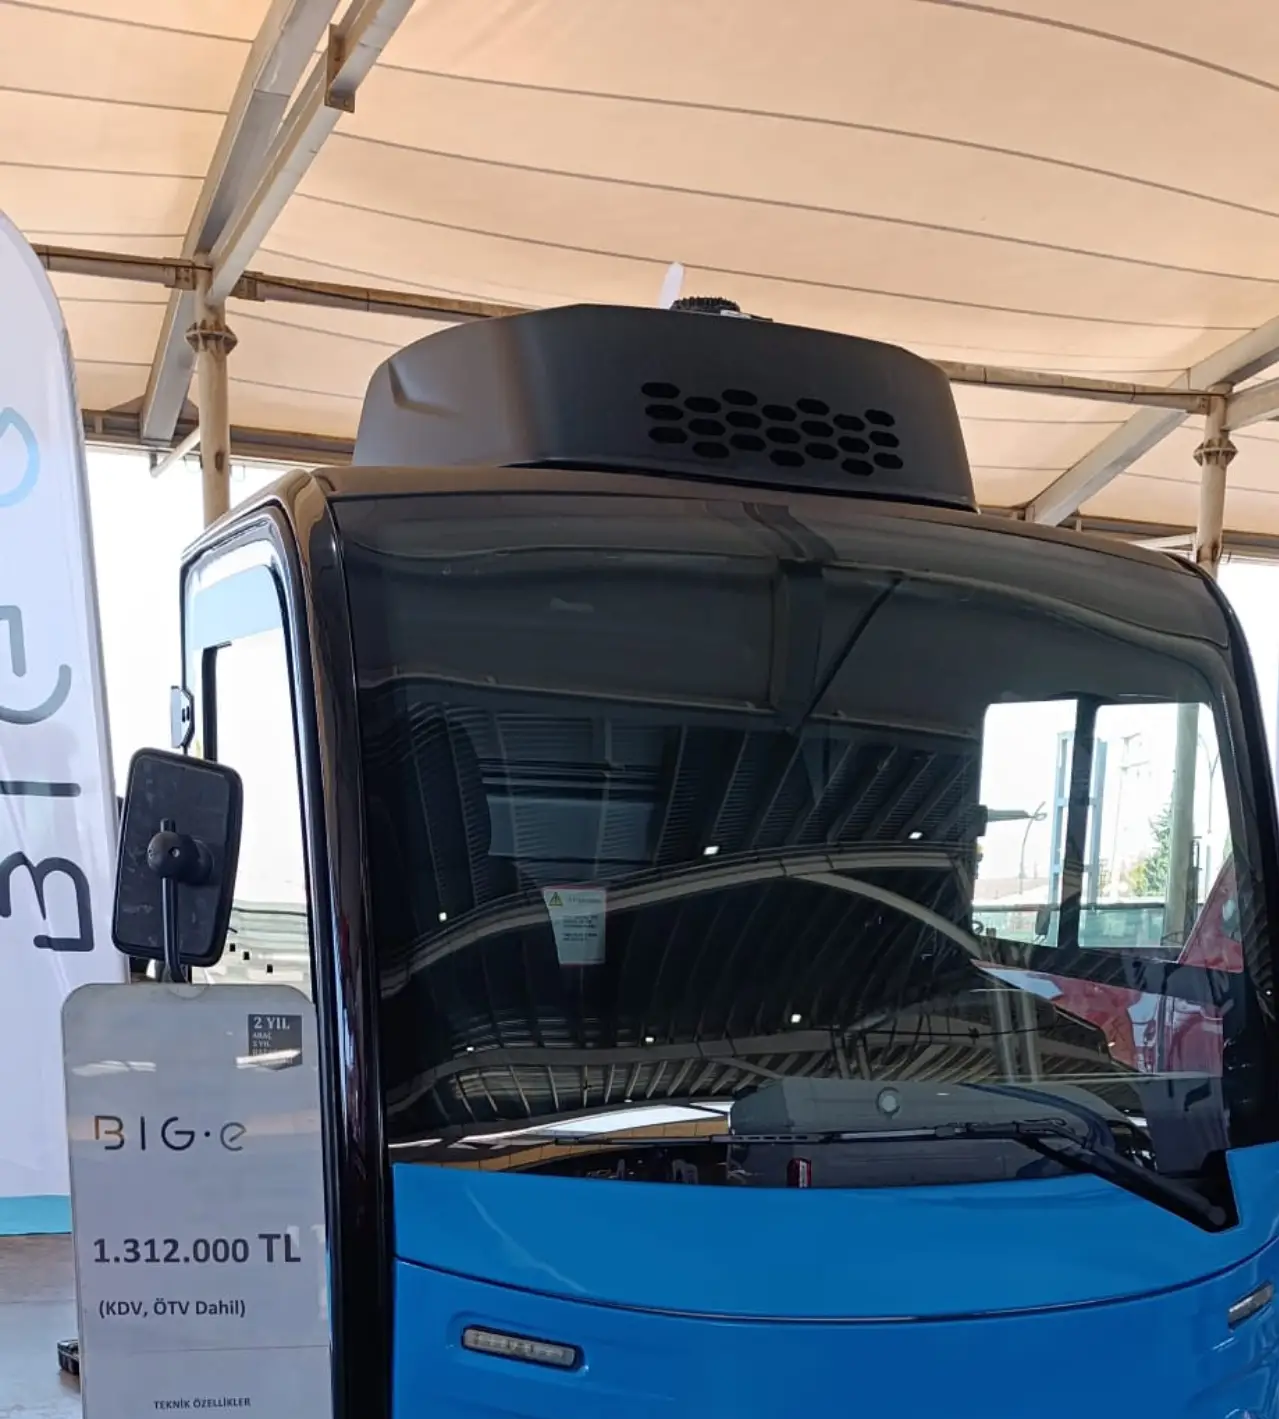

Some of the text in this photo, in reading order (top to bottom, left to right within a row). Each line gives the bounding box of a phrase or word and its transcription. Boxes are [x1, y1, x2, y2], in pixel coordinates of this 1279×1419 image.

[253, 1016, 290, 1030] 2 YIL
[93, 1233, 301, 1264] 1.312.000 TL
[98, 1298, 246, 1319] (KDV, ÖTV Dahil)
[154, 1397, 251, 1410] TEKNİK ÖZELLİKLER
